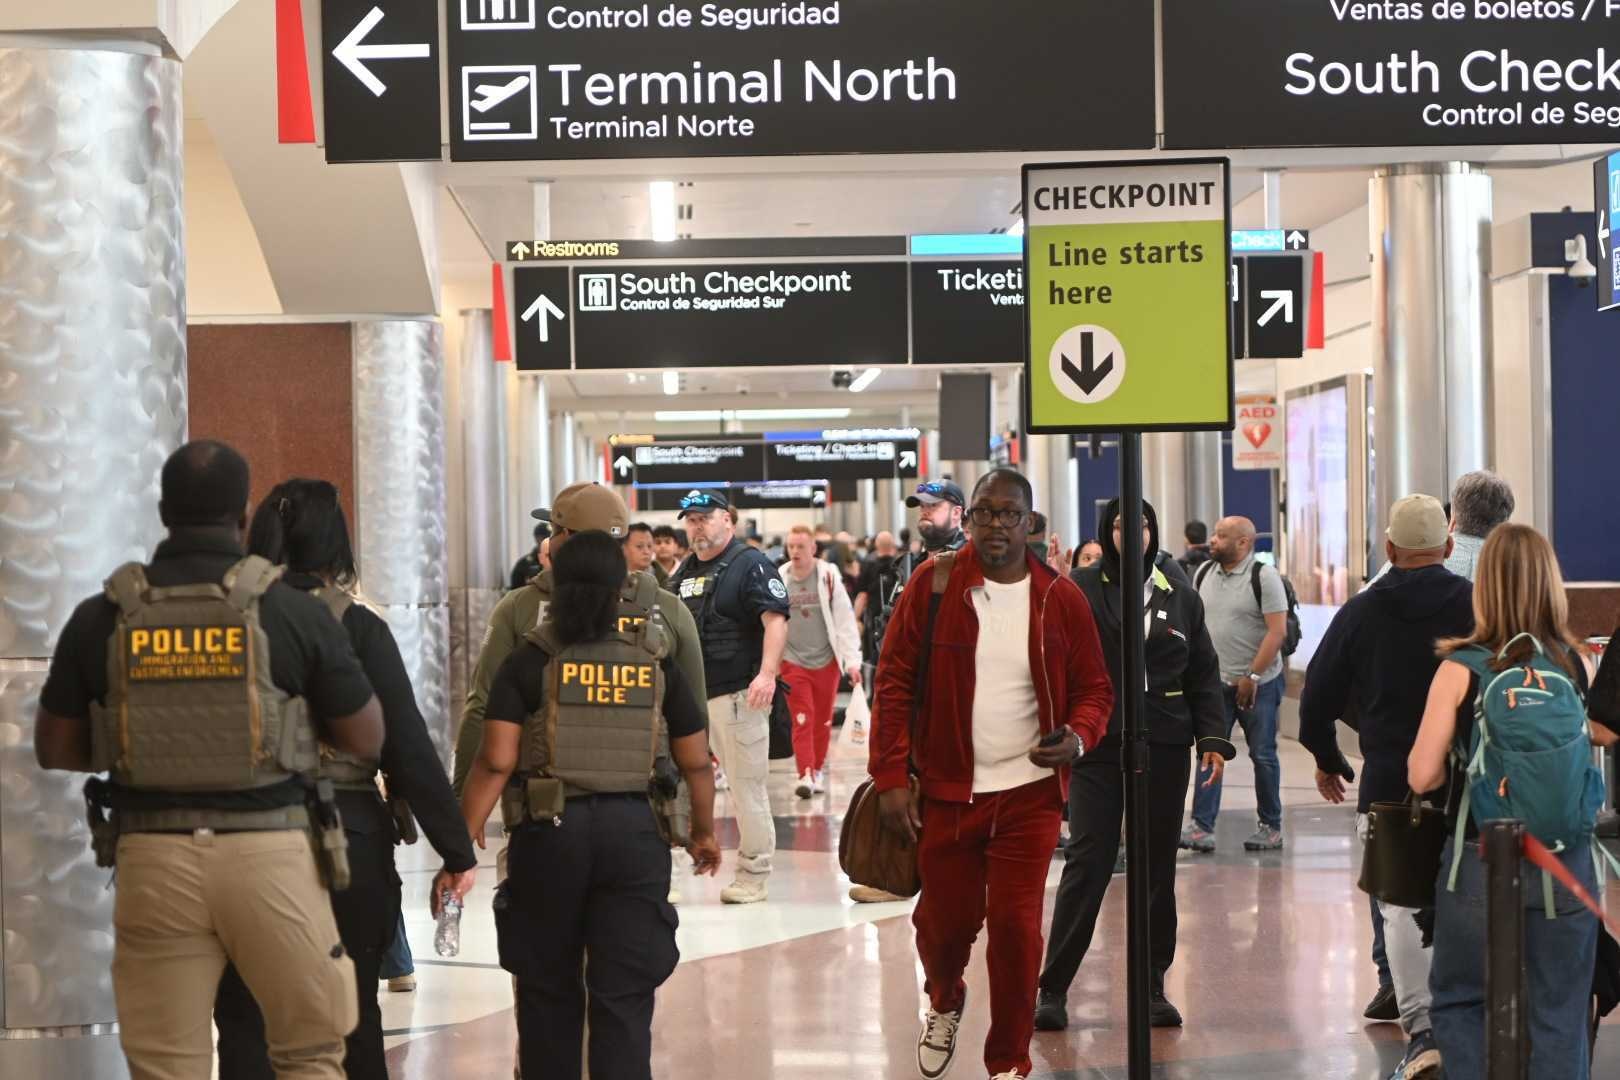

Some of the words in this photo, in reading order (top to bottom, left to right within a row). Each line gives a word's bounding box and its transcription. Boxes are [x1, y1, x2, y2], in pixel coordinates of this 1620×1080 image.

[548, 4, 648, 28] Control
[658, 4, 691, 27] de
[701, 1, 839, 30] Seguridad
[1330, 0, 1423, 20] Ventas
[1432, 0, 1465, 19] de
[1475, 0, 1574, 19] boletos
[549, 59, 781, 105] Terminal
[805, 57, 955, 101] North
[1285, 50, 1439, 94] South
[1460, 48, 1620, 92] Check
[550, 115, 666, 138] Terminal
[678, 115, 754, 136] Norte
[1423, 102, 1521, 125] Control
[1532, 102, 1564, 124] de
[1574, 102, 1620, 127] Seg
[1034, 182, 1215, 210] CHECKPOINT
[533, 240, 619, 257] Restrooms
[1049, 242, 1106, 266] Line
[1120, 241, 1203, 264] starts
[621, 272, 695, 294] South
[704, 271, 851, 296] Checkpoint
[938, 268, 1022, 290] Ticketi
[621, 298, 669, 310] Control
[673, 297, 690, 309] de
[693, 296, 760, 311] Seguridad
[763, 294, 789, 308] Sur
[1050, 280, 1111, 304] here
[1240, 407, 1276, 417] AED
[131, 627, 243, 654] POLICE
[562, 663, 652, 687] POLICE
[588, 687, 625, 703] ICE
